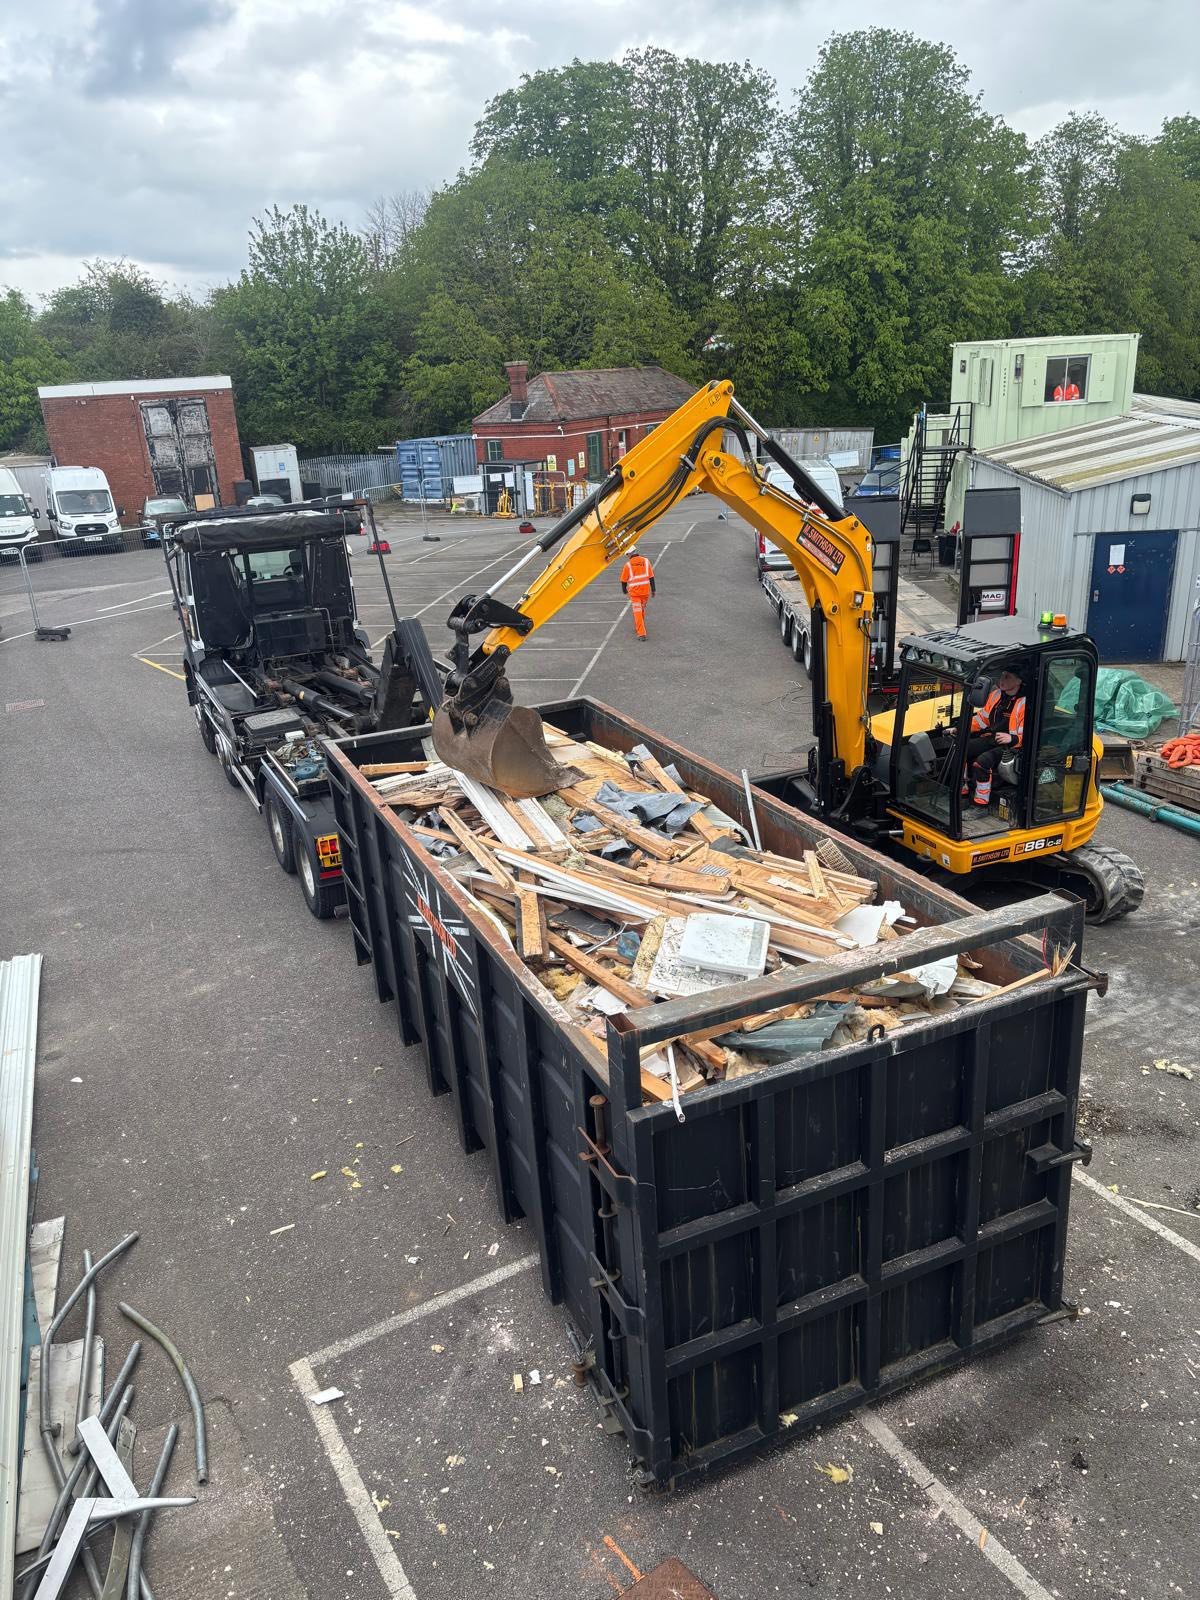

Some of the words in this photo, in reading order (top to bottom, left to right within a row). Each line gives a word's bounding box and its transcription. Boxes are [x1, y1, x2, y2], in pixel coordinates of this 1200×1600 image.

[803, 524, 833, 556] M.SMITHSON
[832, 549, 844, 565] LTD
[1024, 839, 1046, 852] 86
